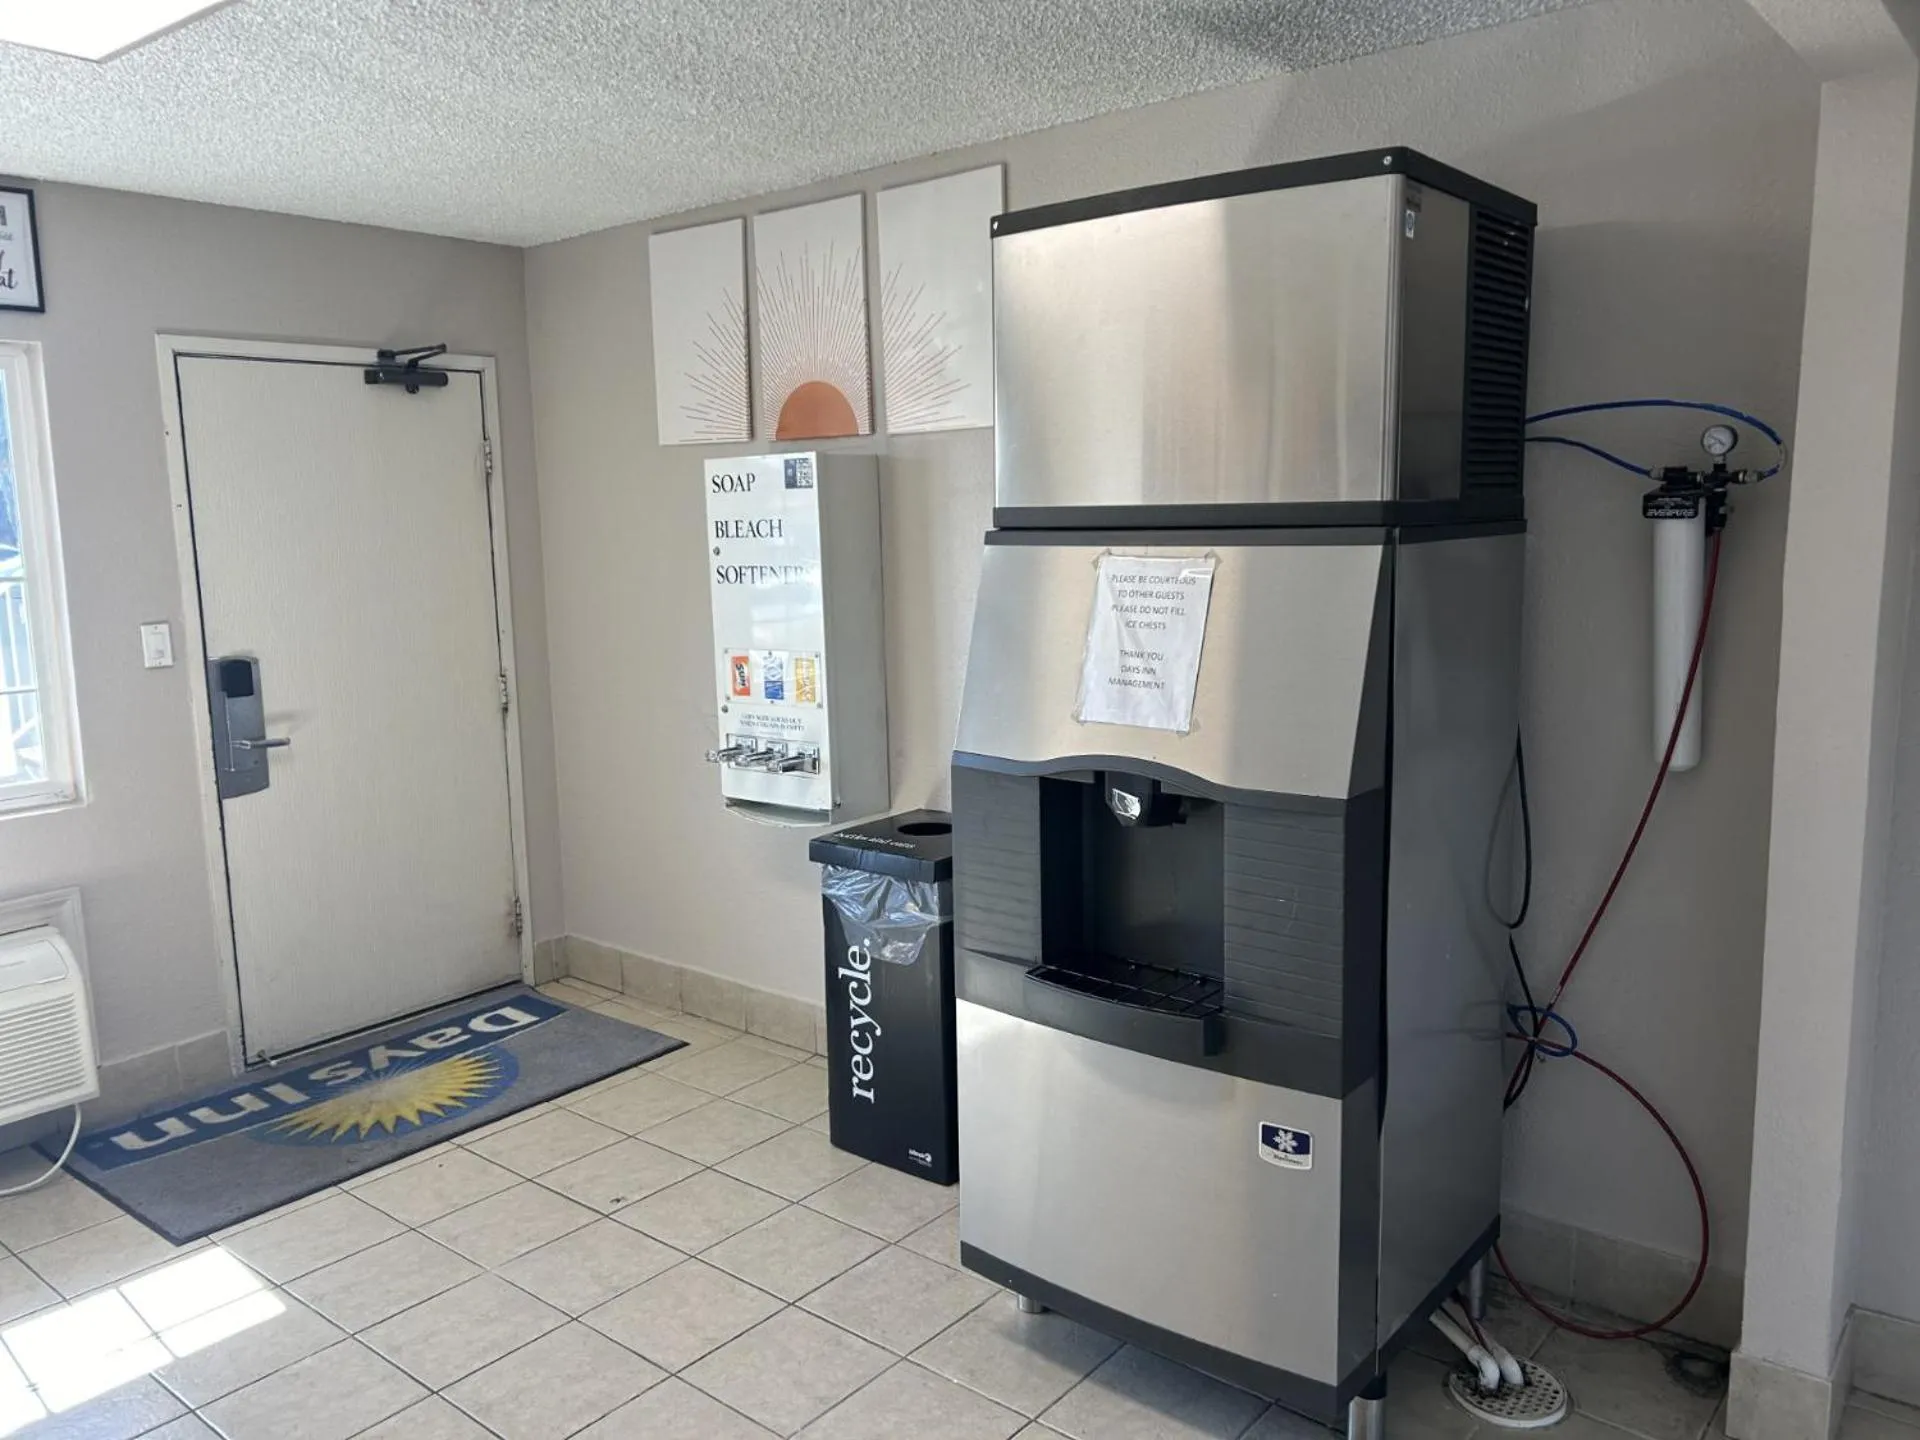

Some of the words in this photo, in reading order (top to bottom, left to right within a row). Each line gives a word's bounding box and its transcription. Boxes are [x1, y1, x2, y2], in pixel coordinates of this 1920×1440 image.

[712, 472, 756, 494] SOAP
[715, 519, 784, 539] BLEACH
[1111, 574, 1137, 584] PLEASE
[1139, 575, 1148, 584] BE
[1148, 575, 1197, 586] COURTEOUS
[1118, 589, 1128, 598] TO
[1128, 590, 1153, 599] OTHER
[1155, 591, 1185, 600] GUESTS
[1111, 604, 1138, 614] PLEASE
[1139, 605, 1151, 614] DO
[1152, 606, 1168, 615] NOT
[1170, 606, 1186, 616] FILL
[1125, 620, 1136, 629] ICE
[1120, 649, 1144, 659] THANK
[1146, 651, 1164, 661] YOU
[1120, 665, 1140, 674] DAYS
[1141, 666, 1156, 676] INN
[1108, 677, 1165, 690] MANAGEMENT
[838, 938, 882, 1104] recycle.
[308, 1006, 540, 1086] Days
[109, 1082, 311, 1150] Inn
